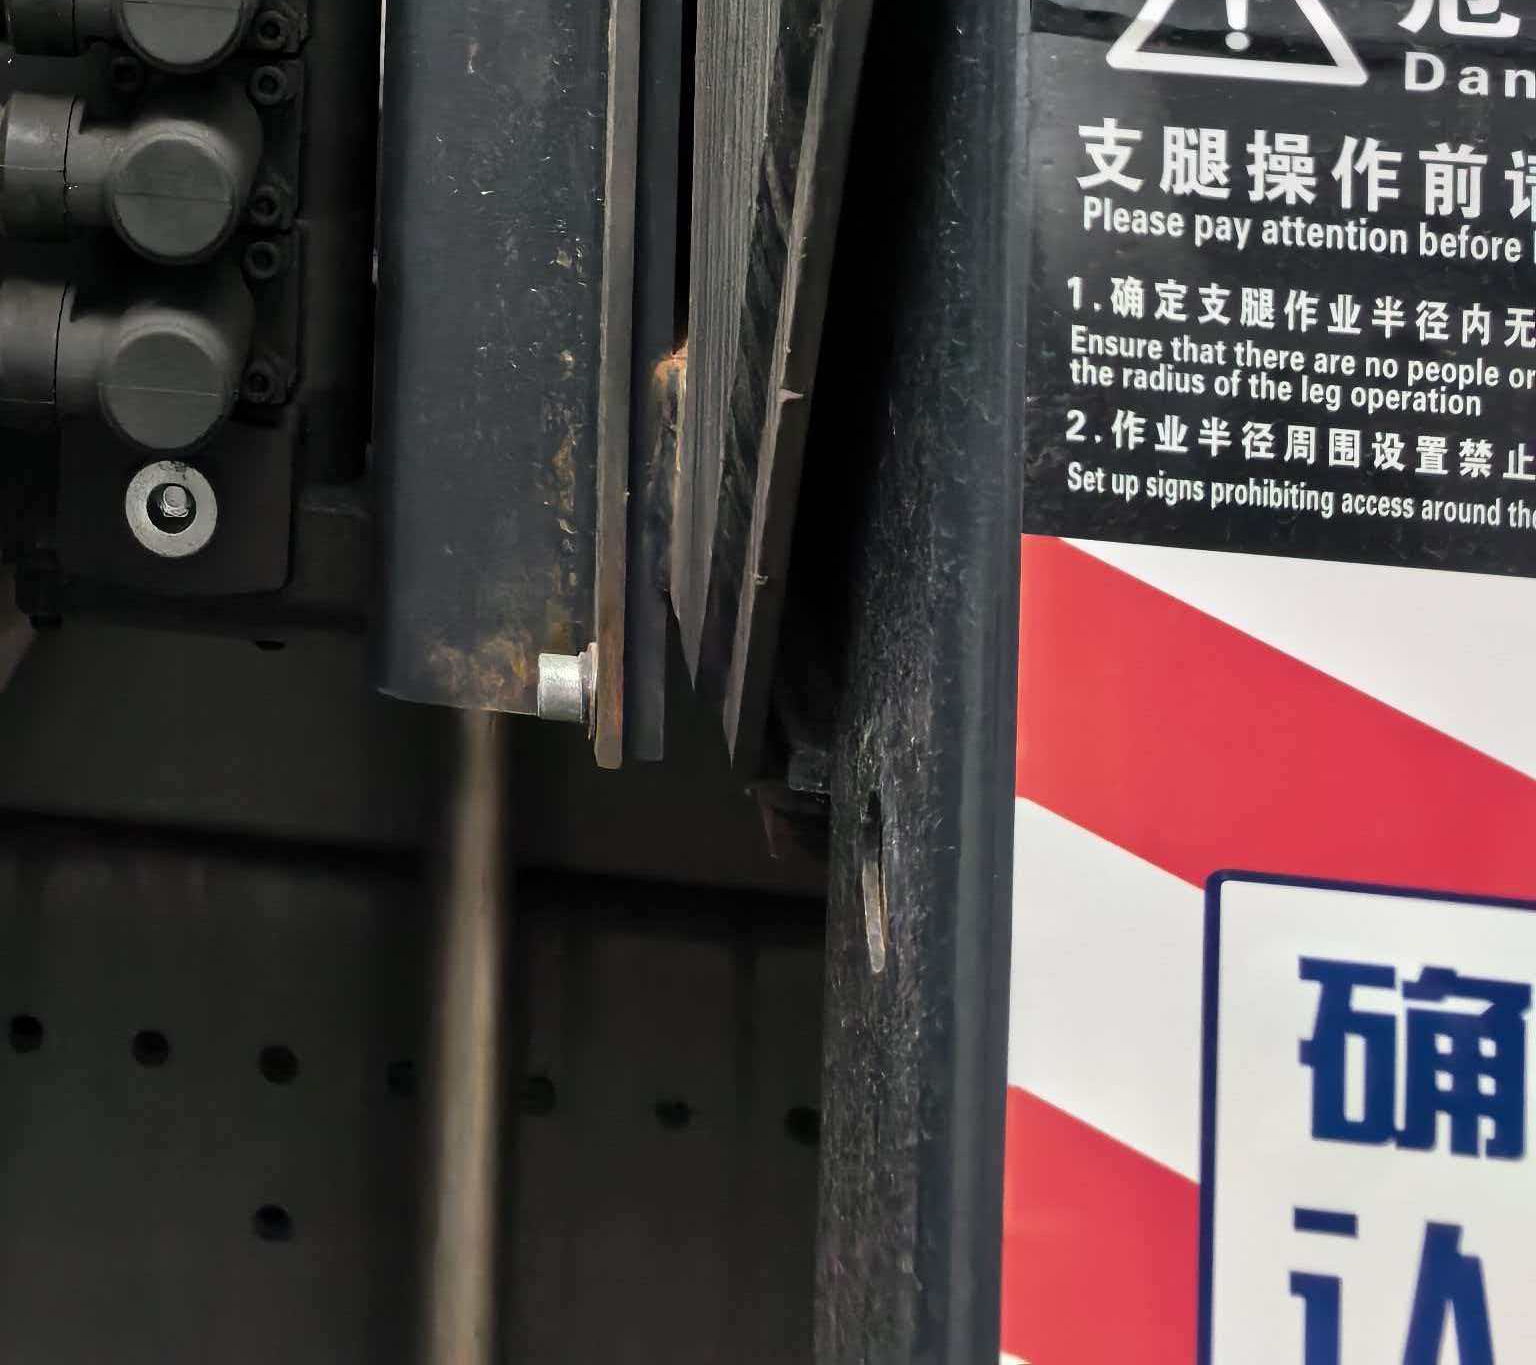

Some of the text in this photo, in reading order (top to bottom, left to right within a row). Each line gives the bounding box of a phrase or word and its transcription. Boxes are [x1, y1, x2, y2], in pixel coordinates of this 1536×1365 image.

[1404, 50, 1536, 99] Dan
[1083, 195, 1522, 262] Please pay attention before
[1069, 356, 1482, 417] the radius of the leg operation
[1071, 323, 1163, 360] Ensure
[1170, 334, 1227, 366] that
[1233, 339, 1305, 372] there
[1313, 351, 1356, 376] are
[1365, 355, 1399, 379] no
[1407, 356, 1500, 391] people
[1067, 460, 1106, 494] Set
[1111, 472, 1140, 502] up
[1145, 469, 1205, 507] signs
[1210, 476, 1334, 519] prohibiting
[1341, 491, 1415, 518] access
[1421, 496, 1503, 527] around
